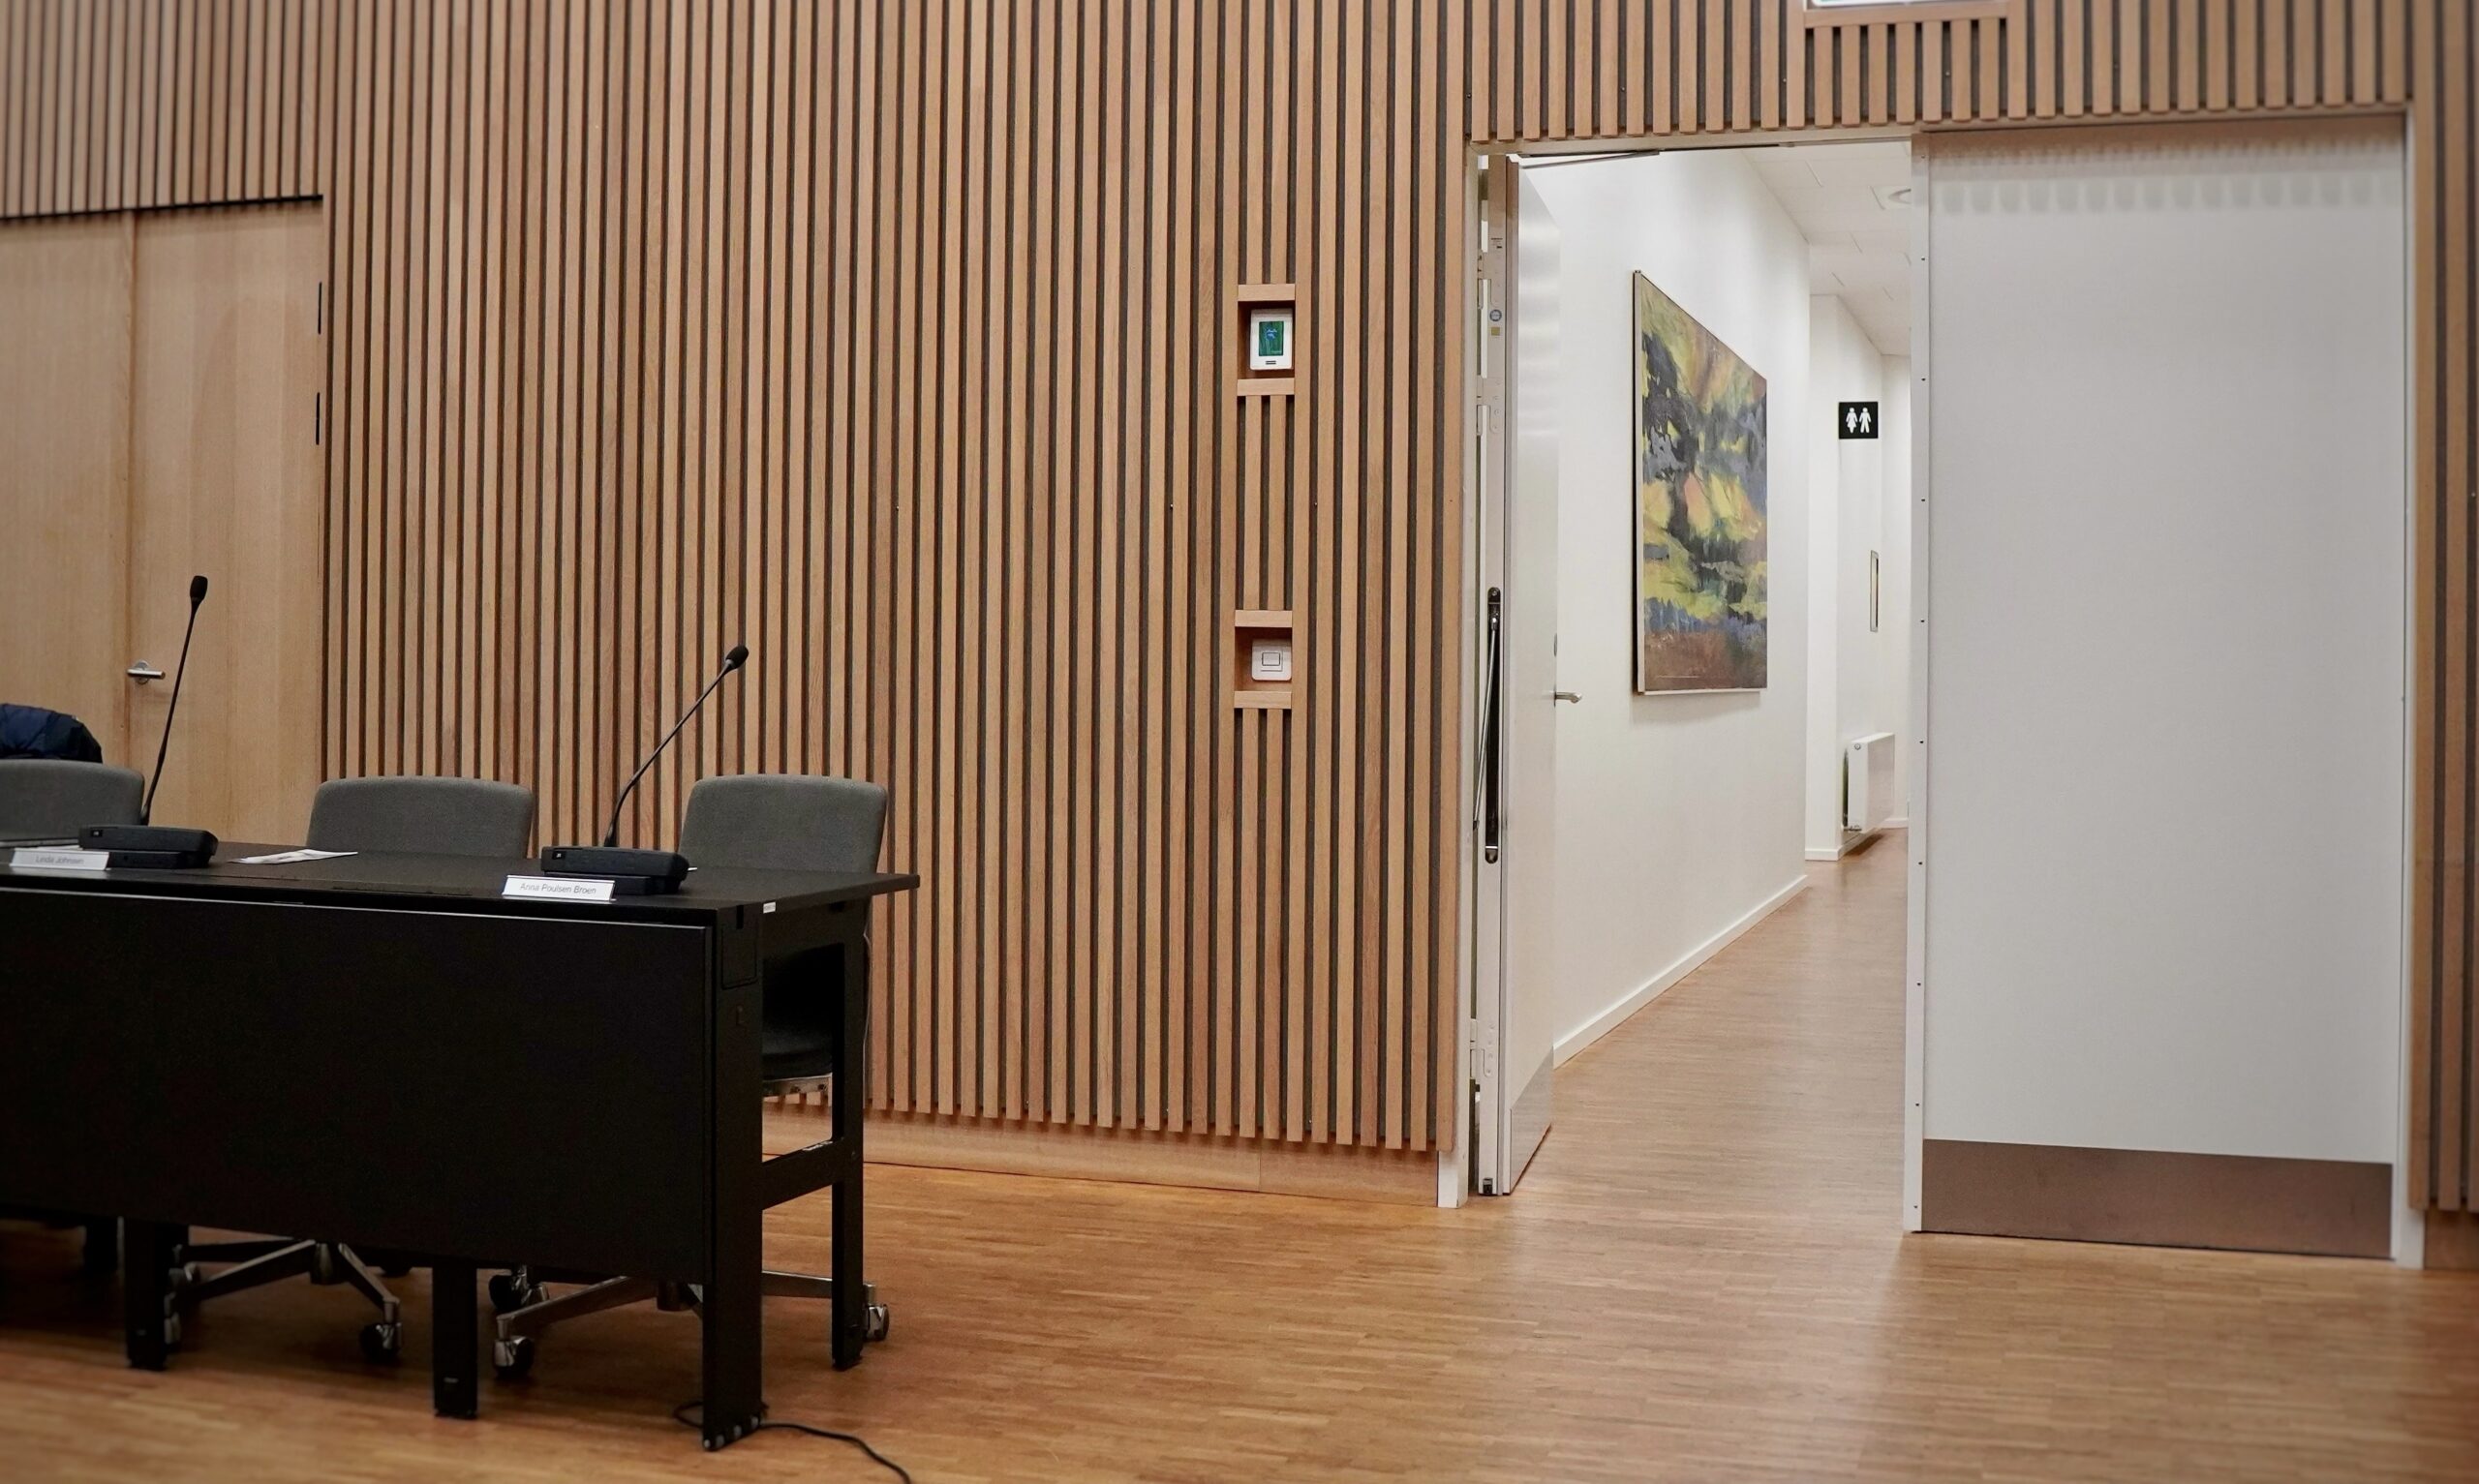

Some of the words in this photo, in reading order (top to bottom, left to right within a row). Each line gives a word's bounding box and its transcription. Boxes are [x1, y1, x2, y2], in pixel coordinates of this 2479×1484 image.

[519, 882, 539, 892] Anna
[541, 883, 572, 893] Poulsen
[573, 885, 597, 894] Broen
